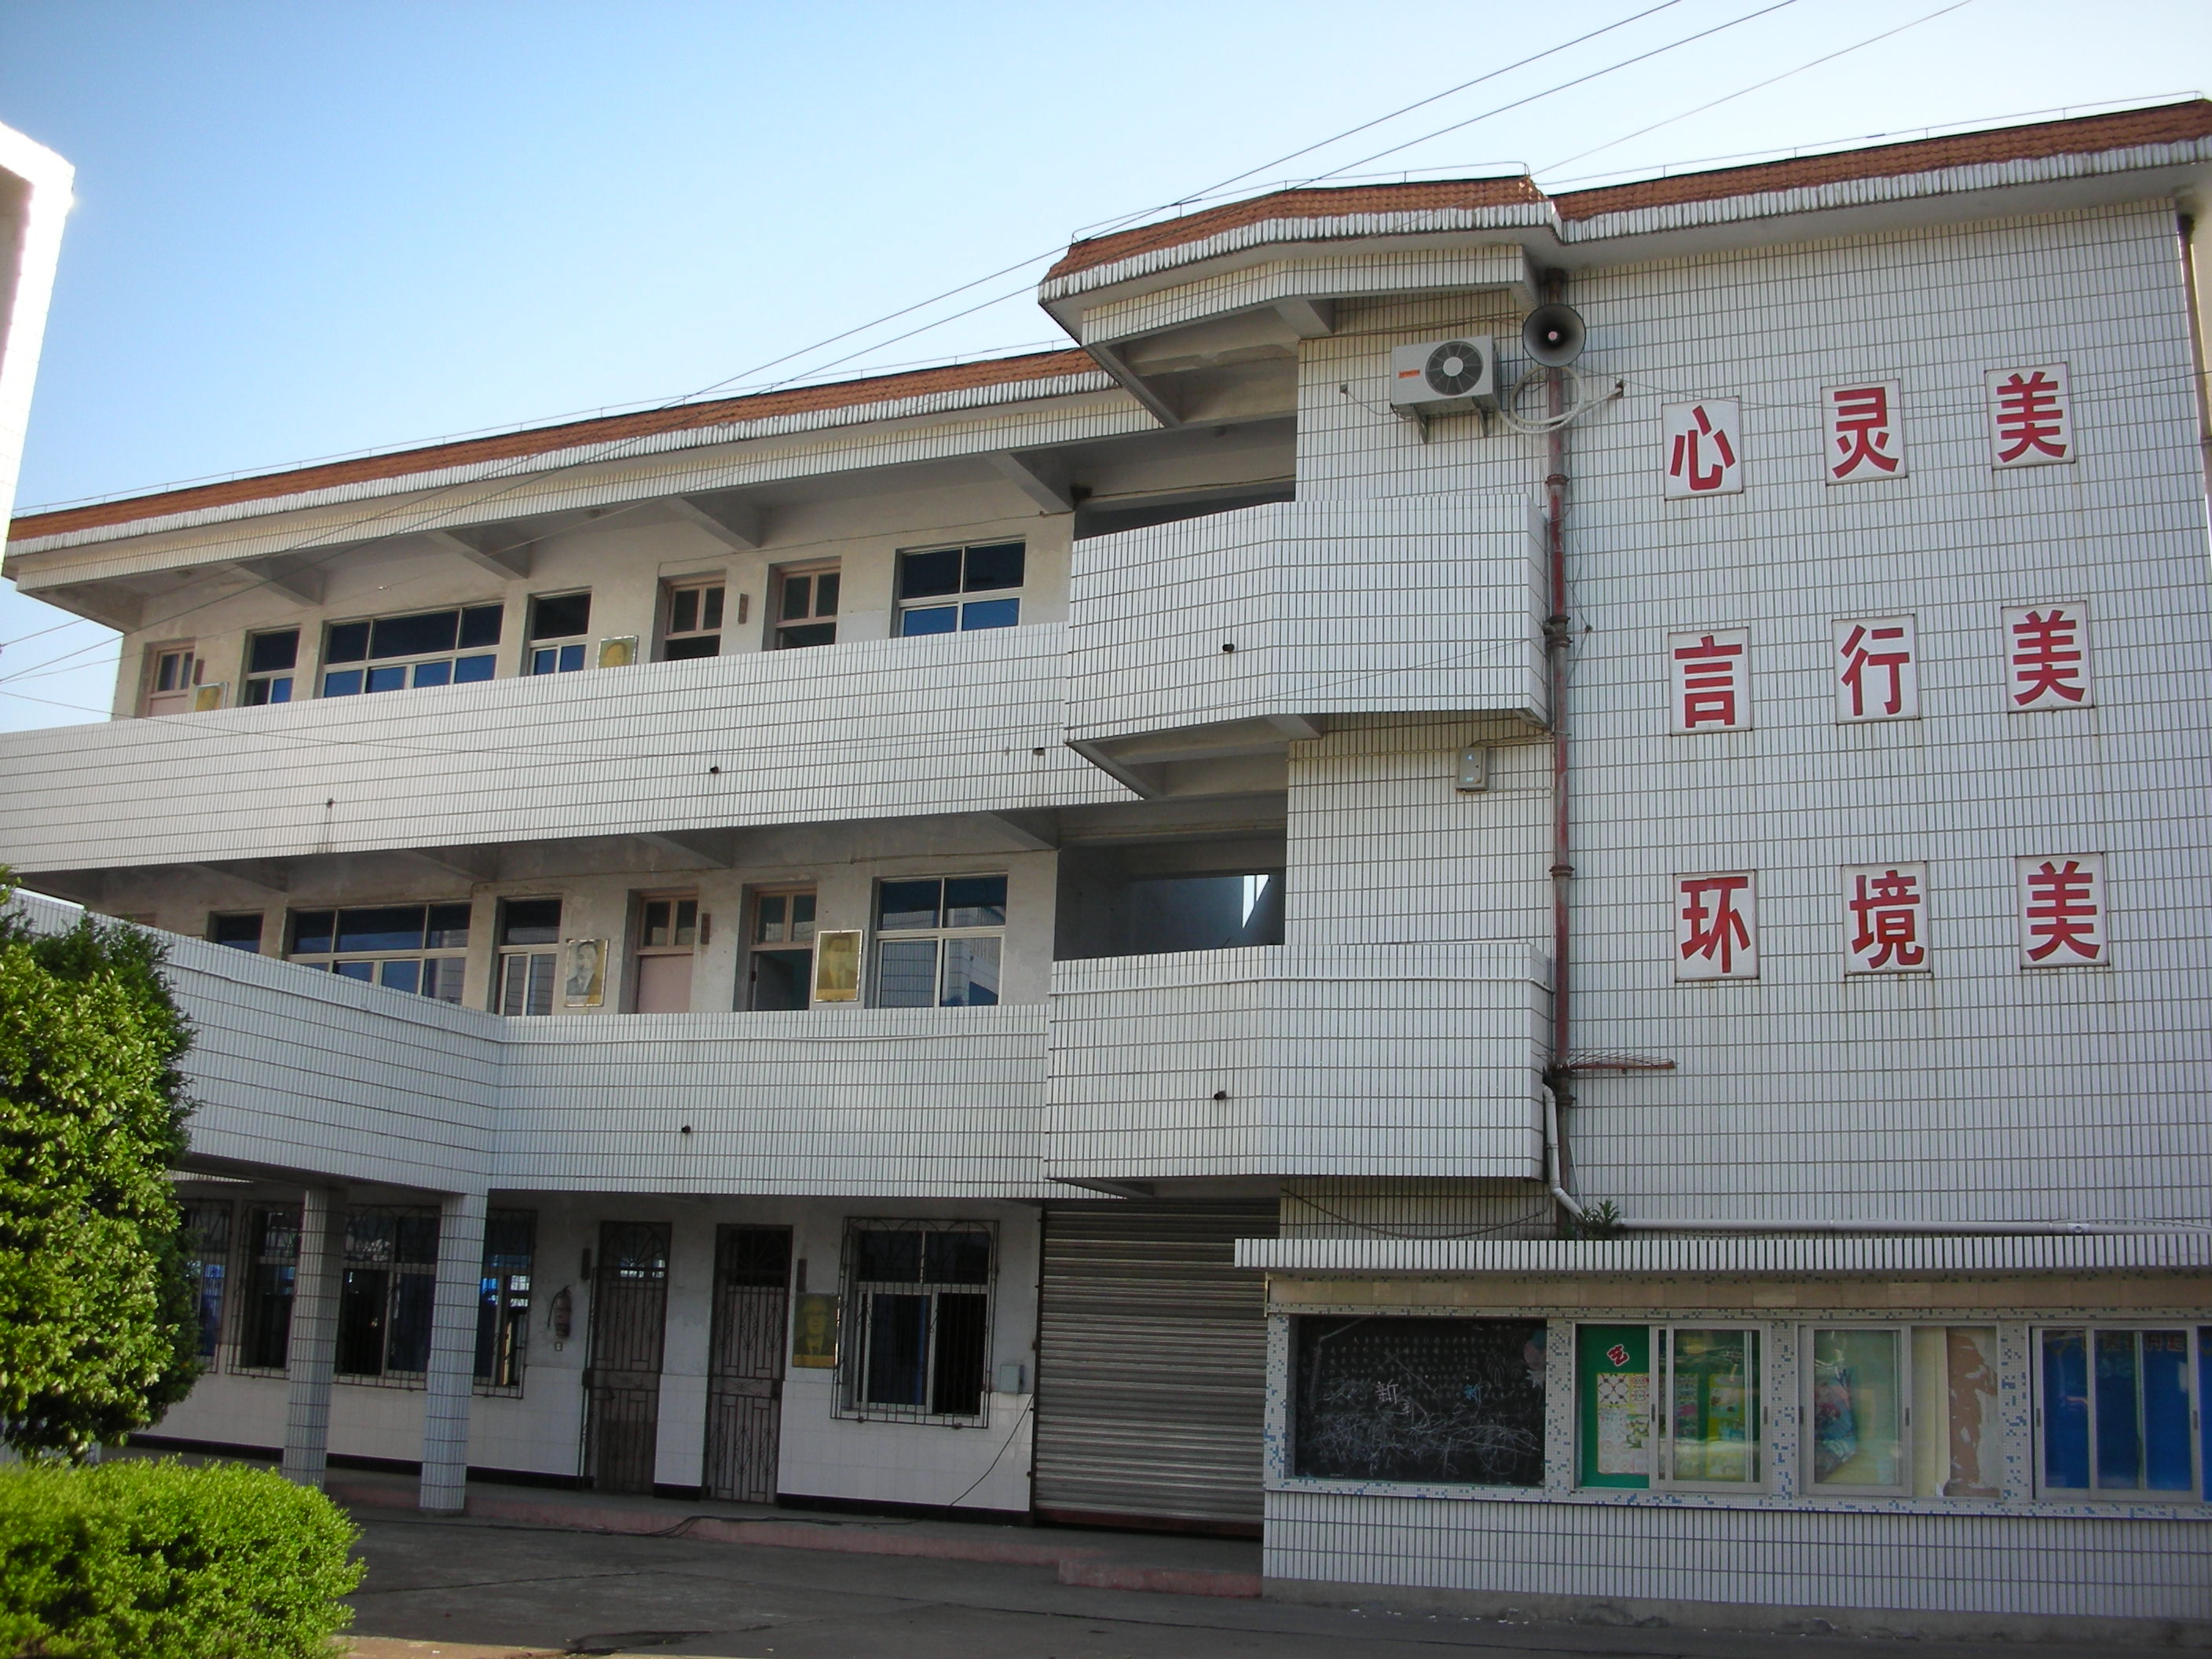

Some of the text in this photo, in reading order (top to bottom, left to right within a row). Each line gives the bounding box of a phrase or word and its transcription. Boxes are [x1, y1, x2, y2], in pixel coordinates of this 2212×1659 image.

[1670, 372, 2067, 491] 心灵美
[1675, 610, 2085, 727] 言行美
[1680, 860, 2100, 972] 环境美
